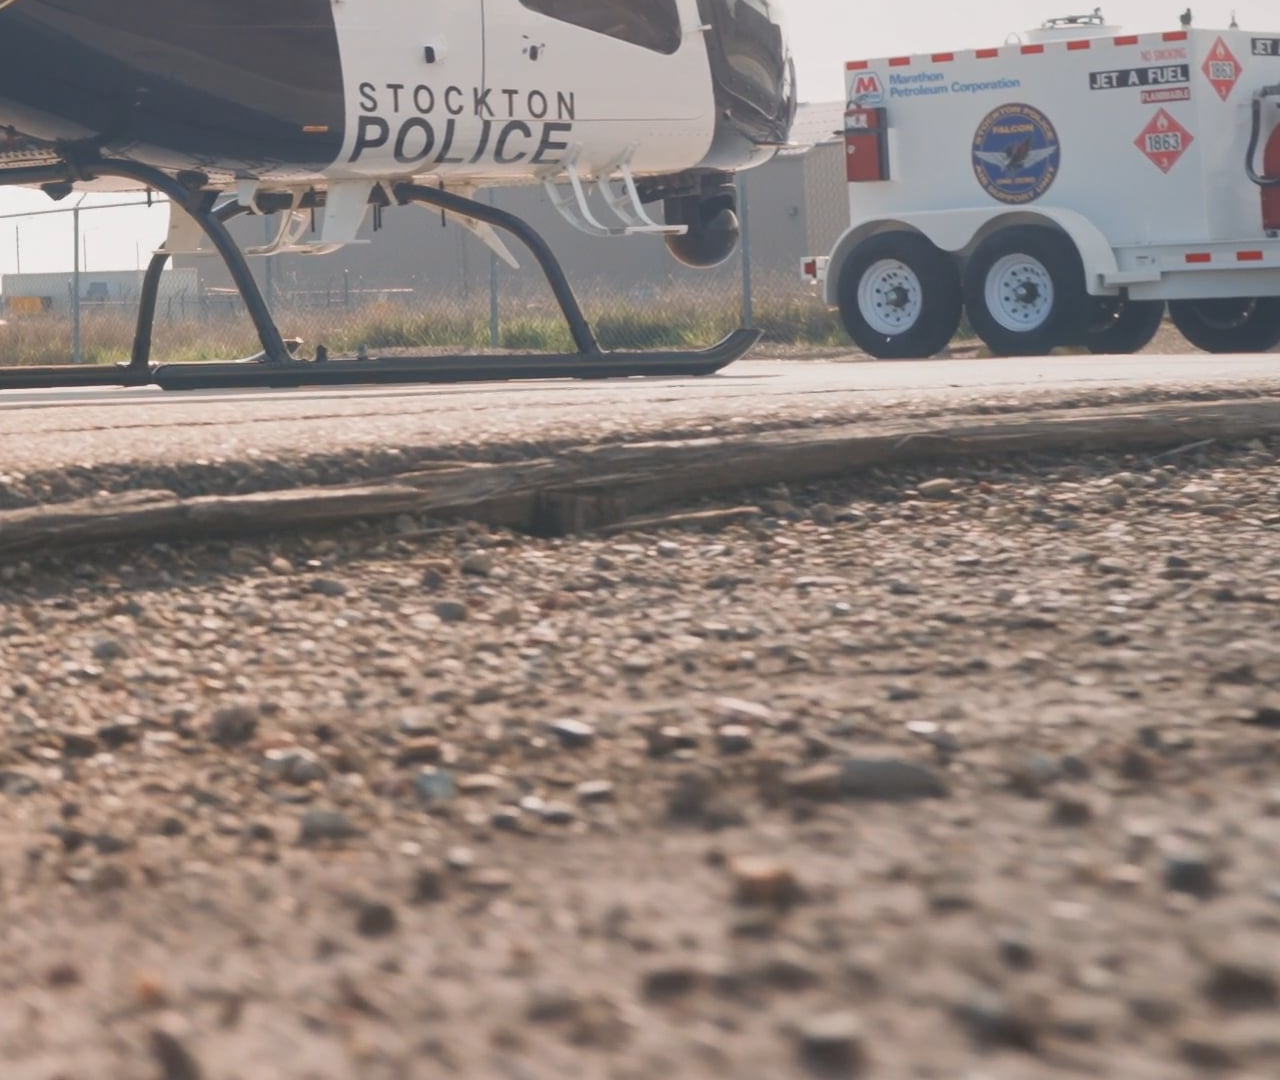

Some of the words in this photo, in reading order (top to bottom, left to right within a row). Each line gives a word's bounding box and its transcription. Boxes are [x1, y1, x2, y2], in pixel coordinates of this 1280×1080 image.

[1254, 40, 1273, 54] JET
[856, 77, 878, 93] M
[889, 72, 944, 85] Marathon
[1092, 72, 1119, 88] JET
[1128, 71, 1140, 85] A
[1148, 67, 1187, 83] FUEL
[890, 83, 948, 98] Petroleum
[951, 77, 1021, 94] Corporation
[358, 82, 575, 120] STOCKTON
[992, 124, 1034, 134] FALCON
[348, 115, 573, 164] POLICE
[1148, 133, 1180, 150] 1863
